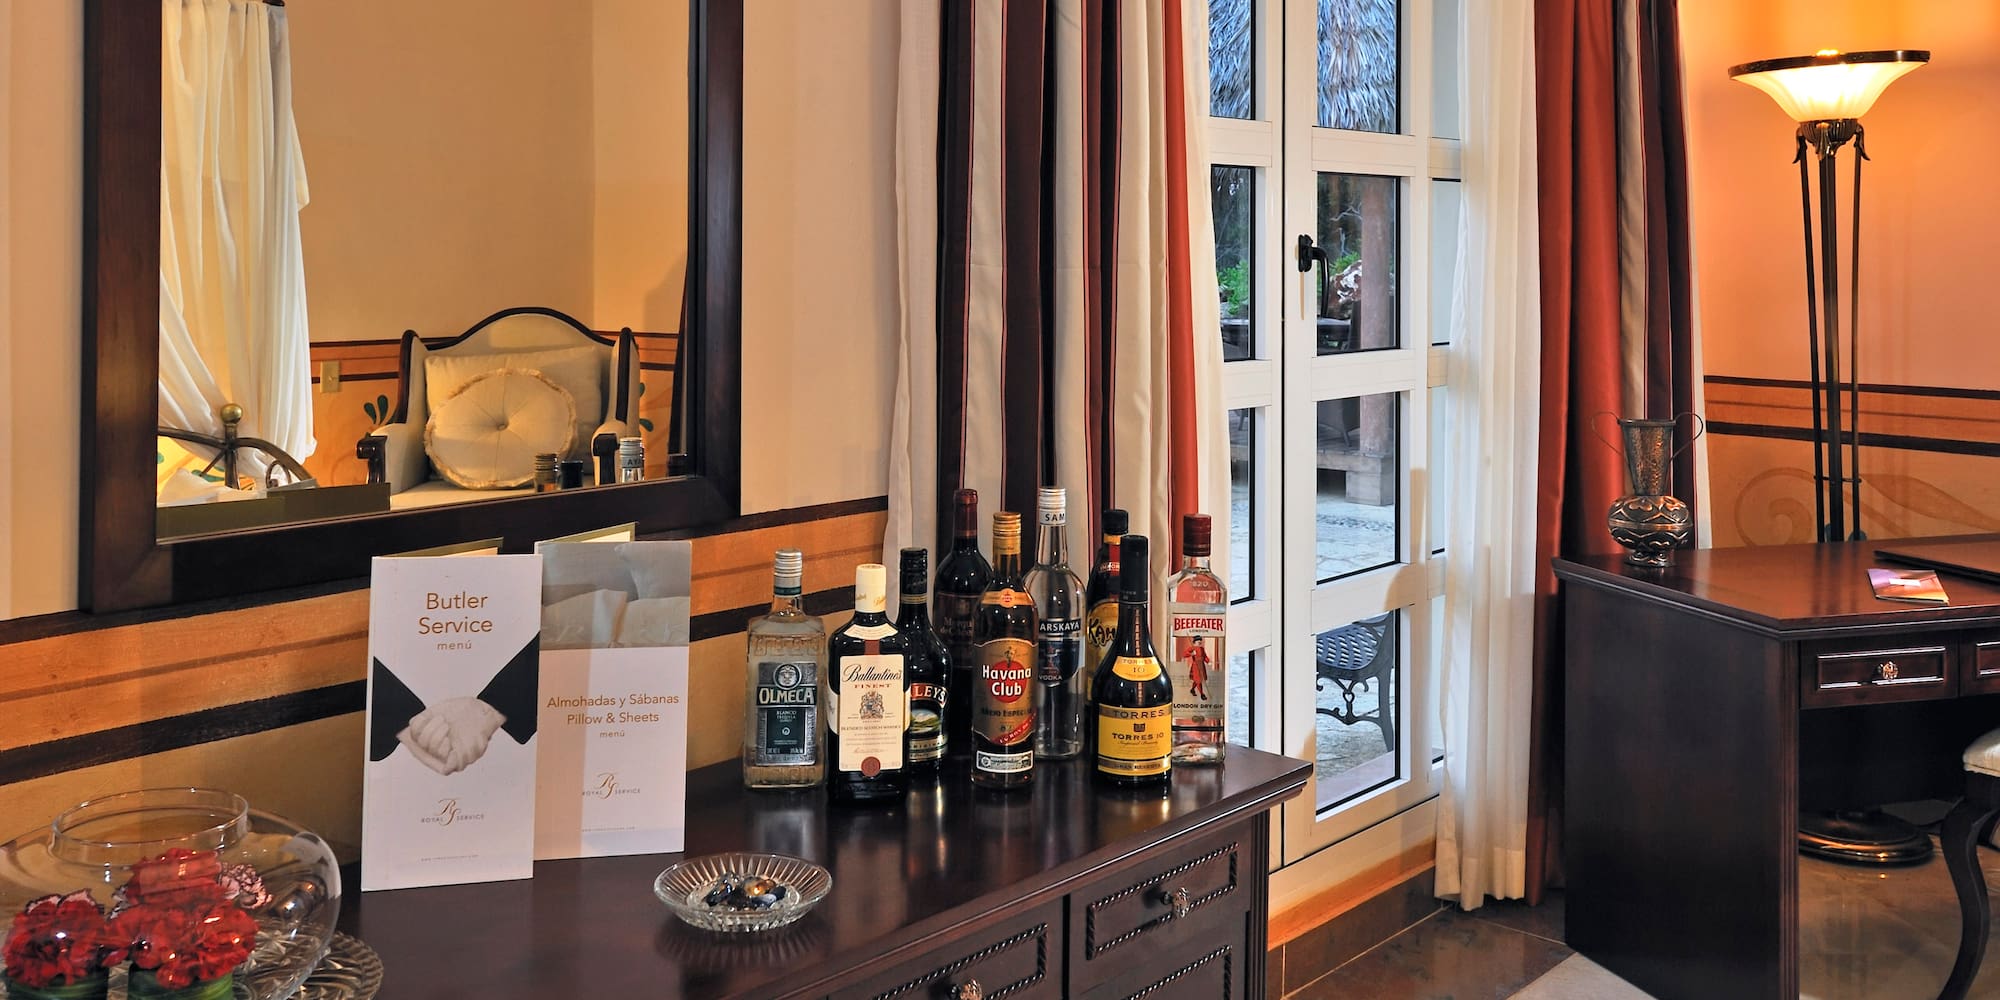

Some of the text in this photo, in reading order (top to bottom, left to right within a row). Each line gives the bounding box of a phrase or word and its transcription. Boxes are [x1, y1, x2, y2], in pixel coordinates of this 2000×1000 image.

[426, 591, 489, 610] Butler
[418, 616, 493, 635] Service
[1174, 618, 1224, 632] BEEFEATER
[436, 640, 472, 651] menú
[982, 664, 1032, 680] Havana
[758, 687, 815, 704] OLMECA
[991, 681, 1022, 696] Club
[546, 692, 680, 708] Almohadas y Sábanas
[567, 711, 660, 725] Pillow & Sheets
[1113, 709, 1165, 719] TORRES
[599, 729, 625, 738] menú
[1111, 732, 1154, 741] TORRES
[456, 813, 484, 821] SERVICE
